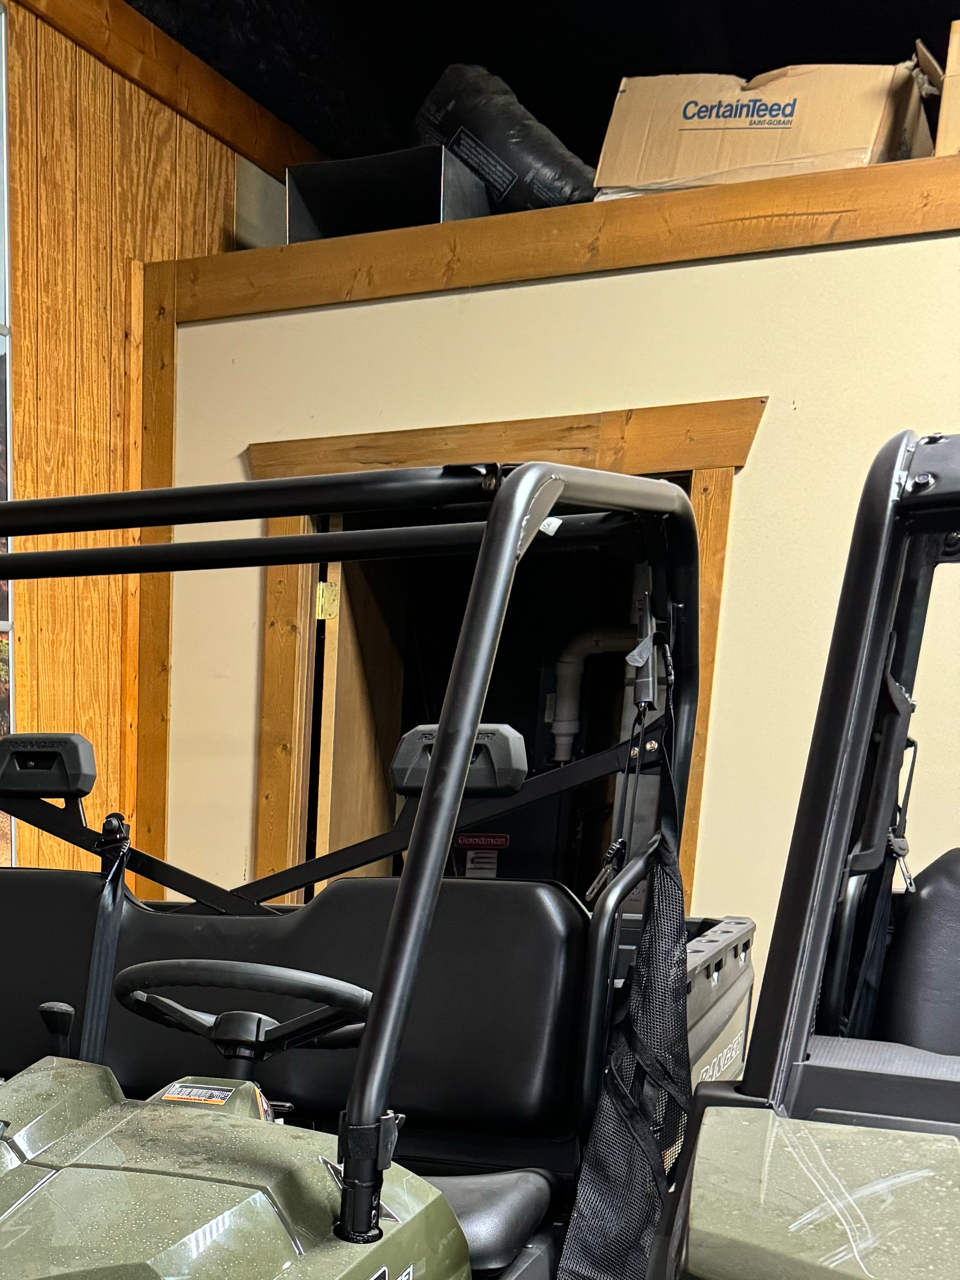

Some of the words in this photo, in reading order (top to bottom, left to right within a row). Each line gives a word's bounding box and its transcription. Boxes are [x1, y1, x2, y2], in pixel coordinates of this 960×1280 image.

[682, 98, 797, 121] CertainTeed
[748, 119, 793, 127] SAINT-GOBAIN
[458, 835, 506, 845] Goodman
